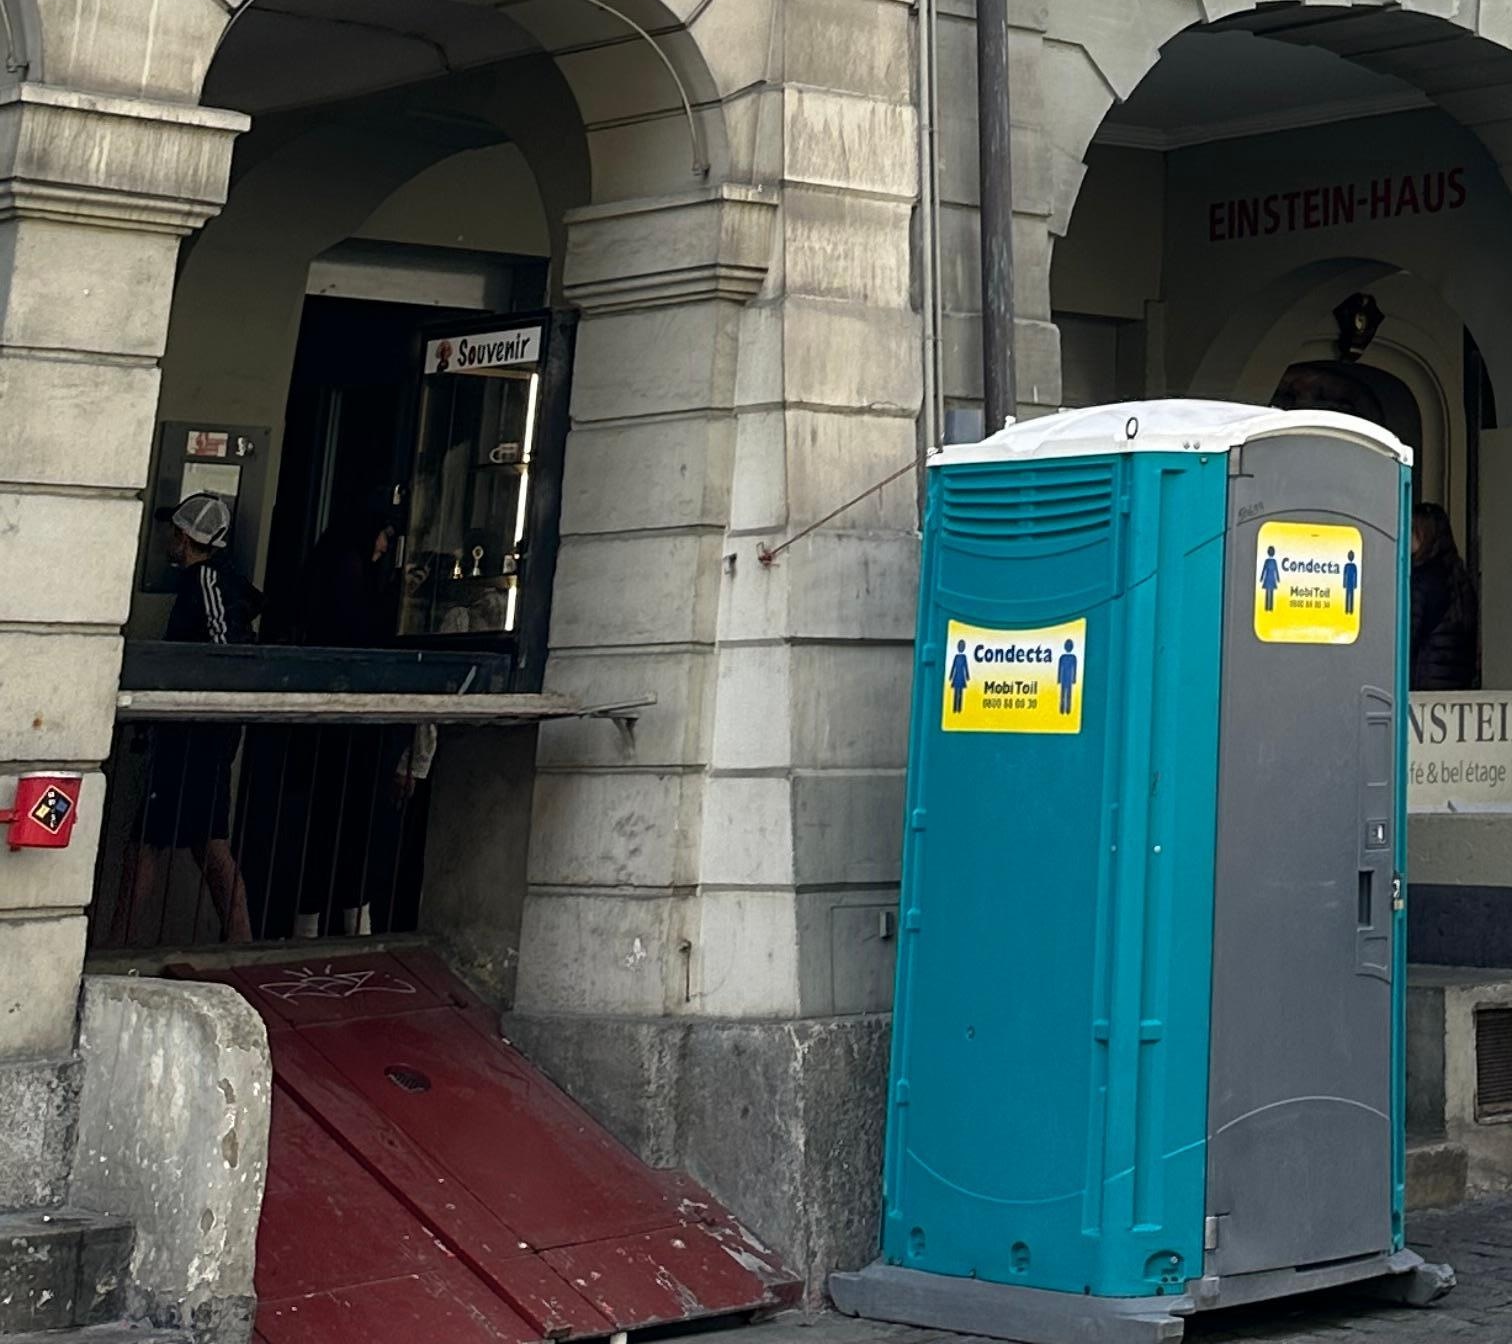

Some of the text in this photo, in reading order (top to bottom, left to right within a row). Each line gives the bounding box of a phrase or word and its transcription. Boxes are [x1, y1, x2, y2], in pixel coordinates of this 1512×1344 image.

[1208, 167, 1467, 242] EINSTEIN-HAUS
[457, 333, 531, 368] Souvenir
[1281, 557, 1341, 574] Condecta
[973, 644, 1053, 663] Condecta
[1441, 759, 1464, 784] bel
[1465, 760, 1506, 787] étage
